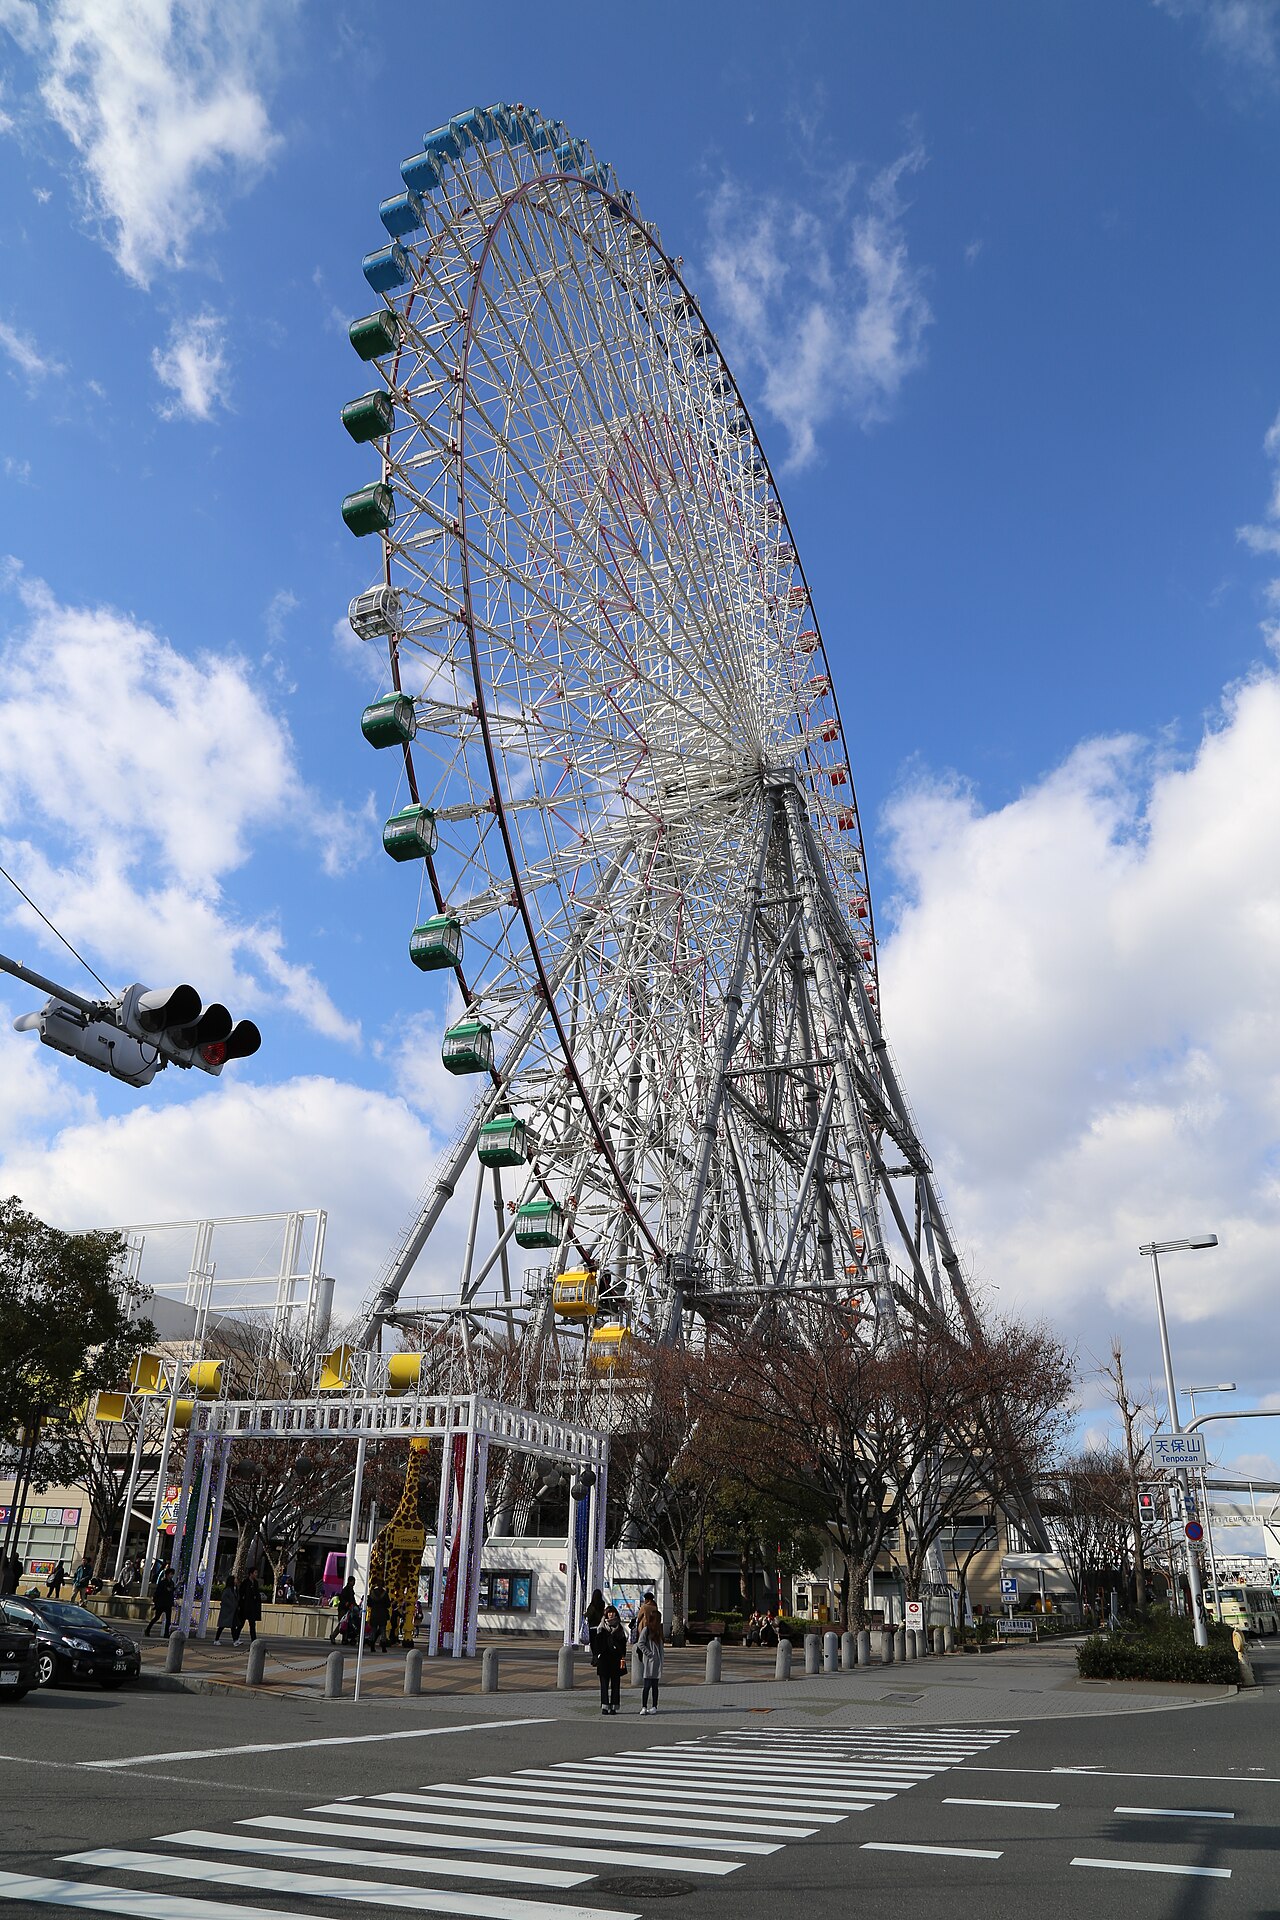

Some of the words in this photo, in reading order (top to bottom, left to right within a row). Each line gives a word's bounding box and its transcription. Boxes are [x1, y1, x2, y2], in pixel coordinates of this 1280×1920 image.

[1155, 1439, 1200, 1453] 天保山
[1161, 1455, 1198, 1463] Tenpozan
[1002, 1580, 1012, 1593] P
